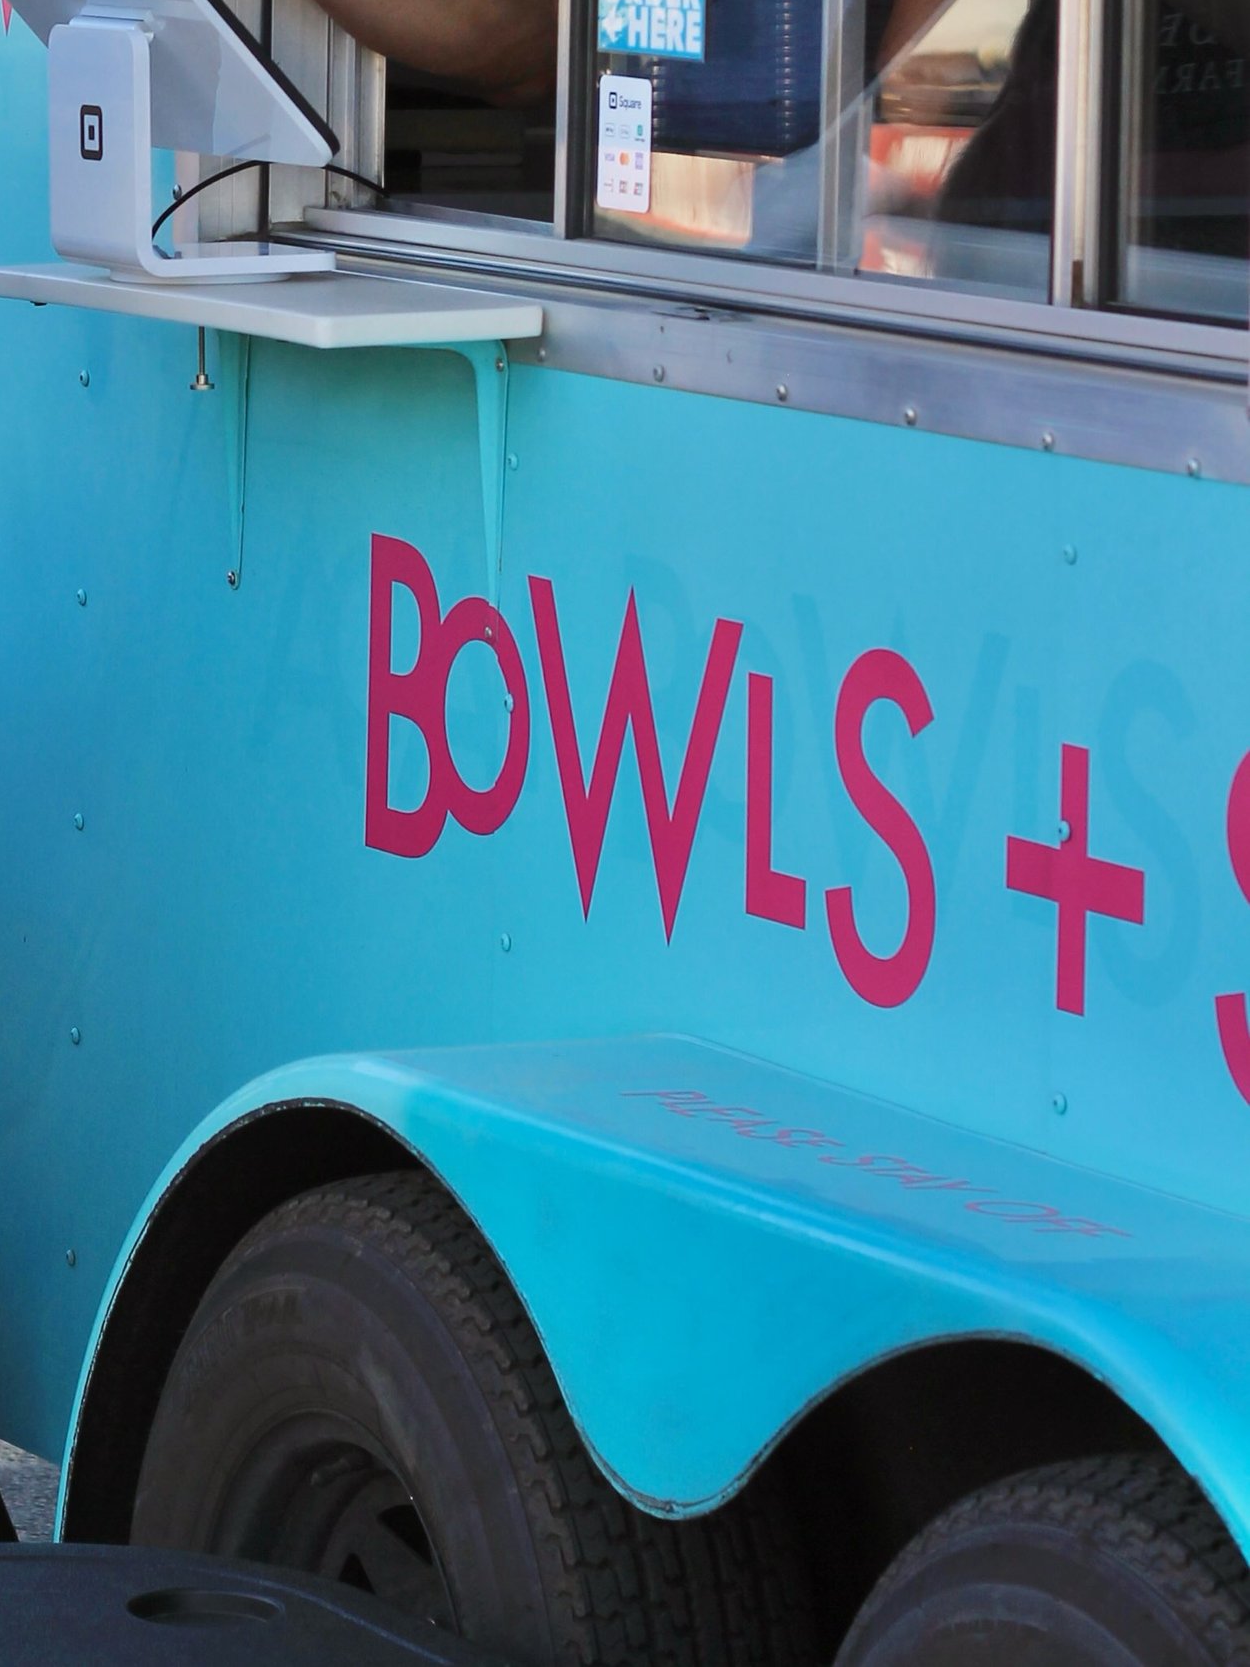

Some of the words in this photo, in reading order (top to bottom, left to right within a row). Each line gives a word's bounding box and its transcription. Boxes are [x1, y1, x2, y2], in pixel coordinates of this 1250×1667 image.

[628, 6, 701, 53] HERE
[619, 96, 642, 110] Square
[365, 532, 936, 1009] BOWLS
[619, 1090, 846, 1148] PLEASE
[817, 1155, 999, 1193] STAY
[965, 1200, 1134, 1237] OFF
